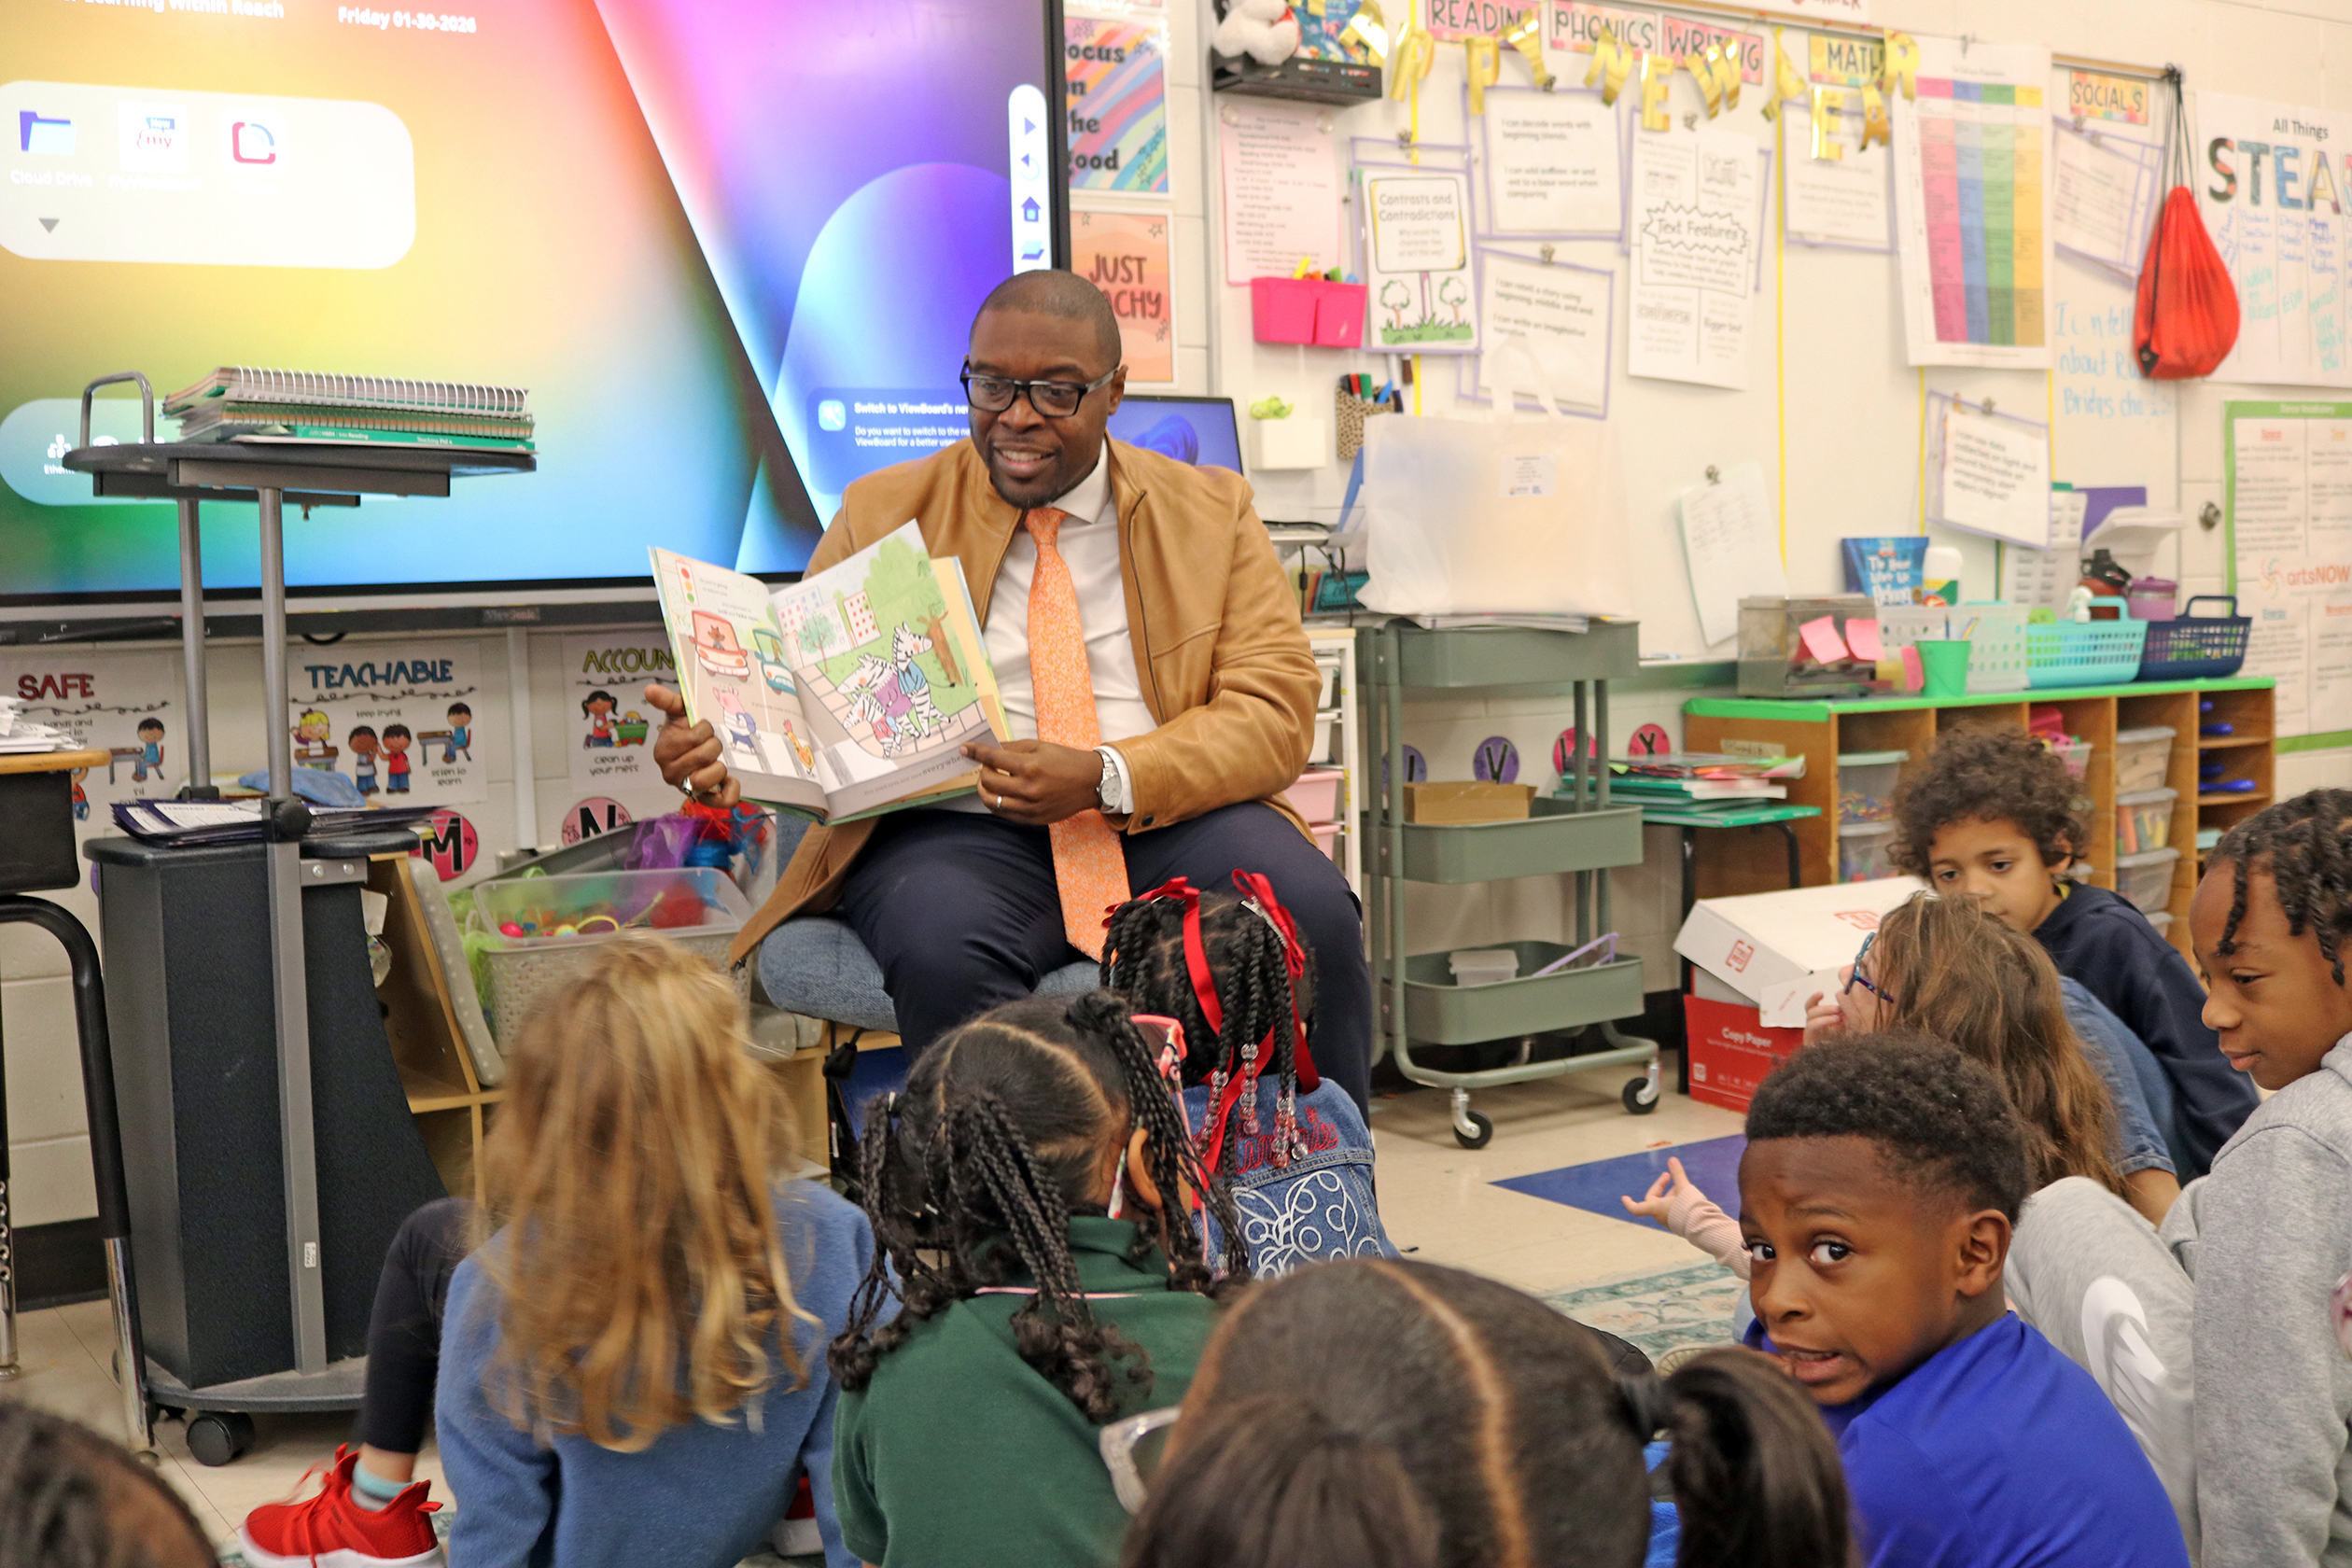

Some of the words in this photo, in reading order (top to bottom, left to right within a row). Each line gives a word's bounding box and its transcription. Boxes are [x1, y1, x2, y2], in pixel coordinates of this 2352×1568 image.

[231, 0, 285, 19] Reach
[338, 6, 390, 31] Friday
[392, 10, 477, 34] 01-30-2026
[1065, 42, 1126, 63] ocus
[2071, 78, 2145, 113] SOCIALS
[1575, 120, 1592, 129] with
[2273, 118, 2289, 133] All
[2291, 120, 2329, 141] Things
[1502, 132, 1540, 141] beginning
[9, 169, 52, 185] Cloud
[55, 171, 93, 187] Drive
[1379, 193, 1430, 205] Contrasts
[1432, 193, 1452, 204] and
[1379, 209, 1456, 222] Contradictions
[1657, 217, 1683, 235] Text
[1687, 219, 1739, 241] Features
[1088, 254, 1147, 283] JUST
[853, 401, 887, 414] Switch
[887, 403, 898, 414] to
[898, 402, 953, 415] ViewBoard's
[348, 432, 369, 441] Reading
[854, 427, 866, 437] Do
[867, 427, 882, 438] you
[883, 427, 902, 437] want
[903, 427, 912, 437] to
[912, 427, 937, 437] switch
[938, 427, 946, 437] to
[946, 427, 959, 437] the
[960, 428, 971, 437] ne
[855, 437, 897, 447] ViewBoard
[898, 437, 909, 447] for
[916, 437, 939, 447] better
[2287, 565, 2351, 587] artsNOW
[304, 658, 453, 689] TEACHABLE
[18, 673, 94, 701] SAFE
[594, 754, 621, 764] clean
[622, 754, 635, 764] up
[1485, 743, 1509, 784] V
[589, 766, 613, 777] your
[615, 763, 639, 774] mess
[420, 817, 463, 872] M
[1721, 1027, 1745, 1045] Copy
[1745, 1031, 1772, 1048] Paper
